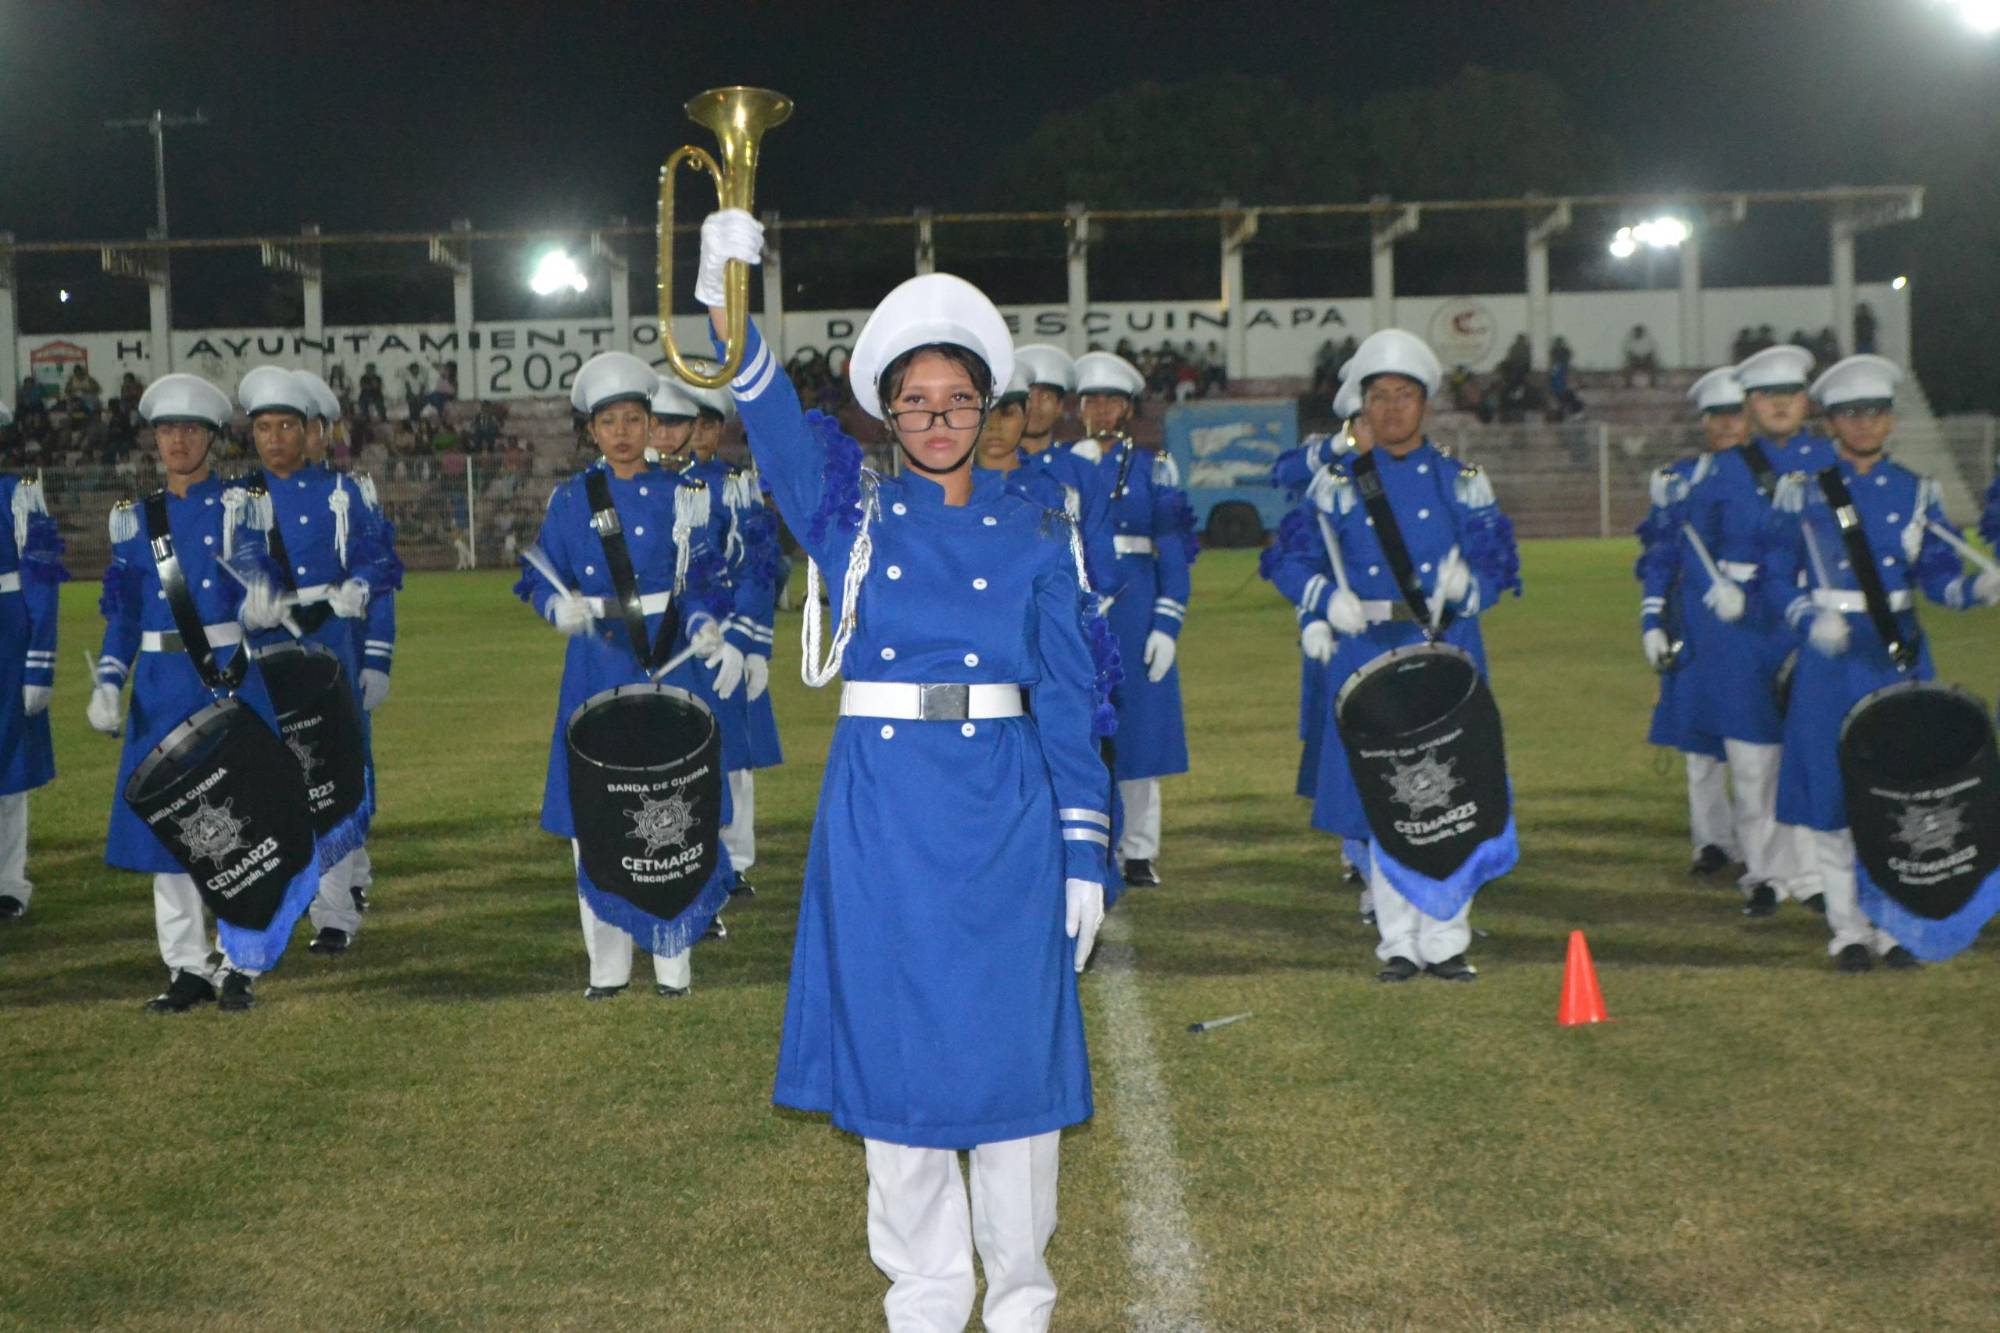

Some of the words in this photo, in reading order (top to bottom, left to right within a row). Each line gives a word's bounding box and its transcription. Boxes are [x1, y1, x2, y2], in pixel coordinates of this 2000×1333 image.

[116, 339, 150, 361] H.
[186, 324, 659, 360] AYUNTAMIENTO
[489, 350, 604, 393] 202
[185, 766, 228, 801] GUERRA
[606, 783, 651, 794] BANDA
[652, 780, 669, 792] DE
[206, 836, 278, 891] CETMAR23
[621, 842, 704, 872] CETMAR23
